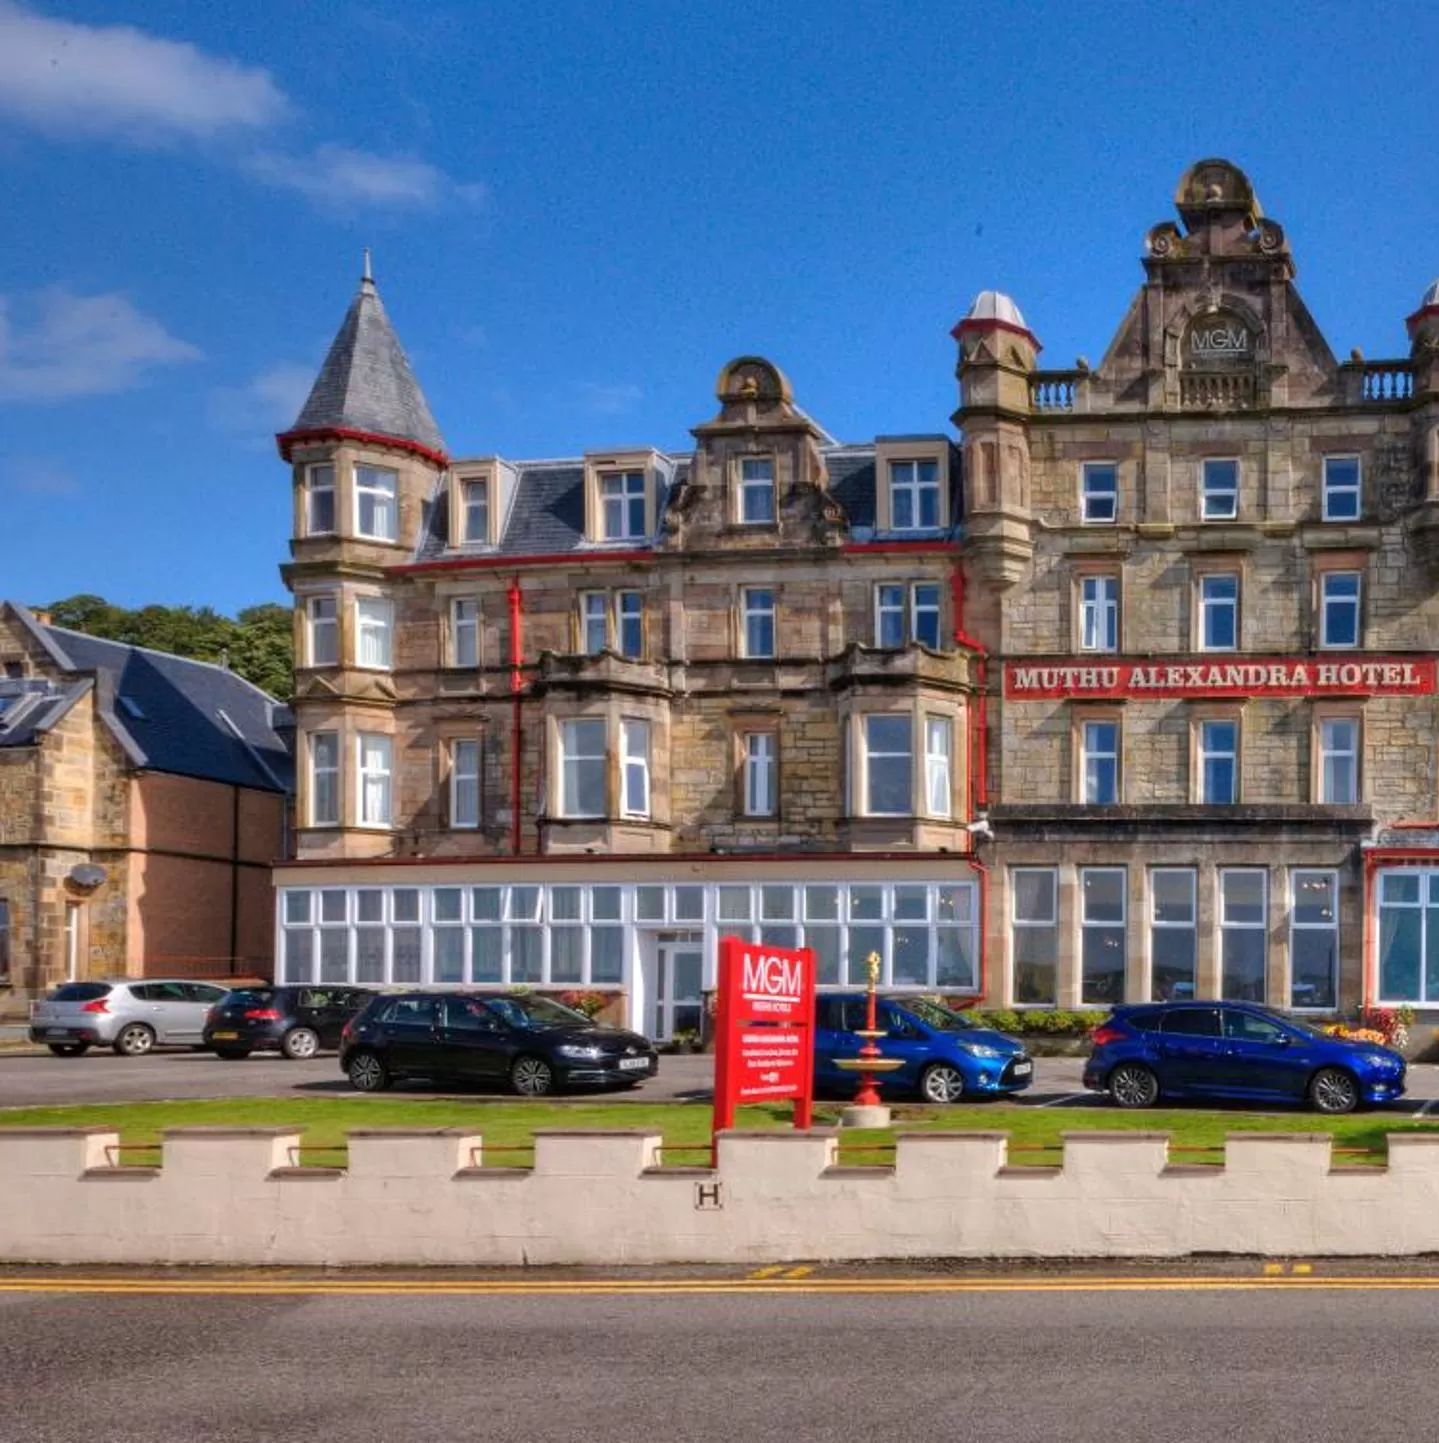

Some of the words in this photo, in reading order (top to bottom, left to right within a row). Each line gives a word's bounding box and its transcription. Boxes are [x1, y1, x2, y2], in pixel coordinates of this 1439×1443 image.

[1191, 329, 1247, 349] MGM
[1013, 668, 1119, 688] MUTHU
[1127, 667, 1309, 687] ALEXANDRA
[1317, 663, 1421, 686] HOTEL
[743, 953, 802, 994] MGM
[699, 1184, 718, 1205] H
